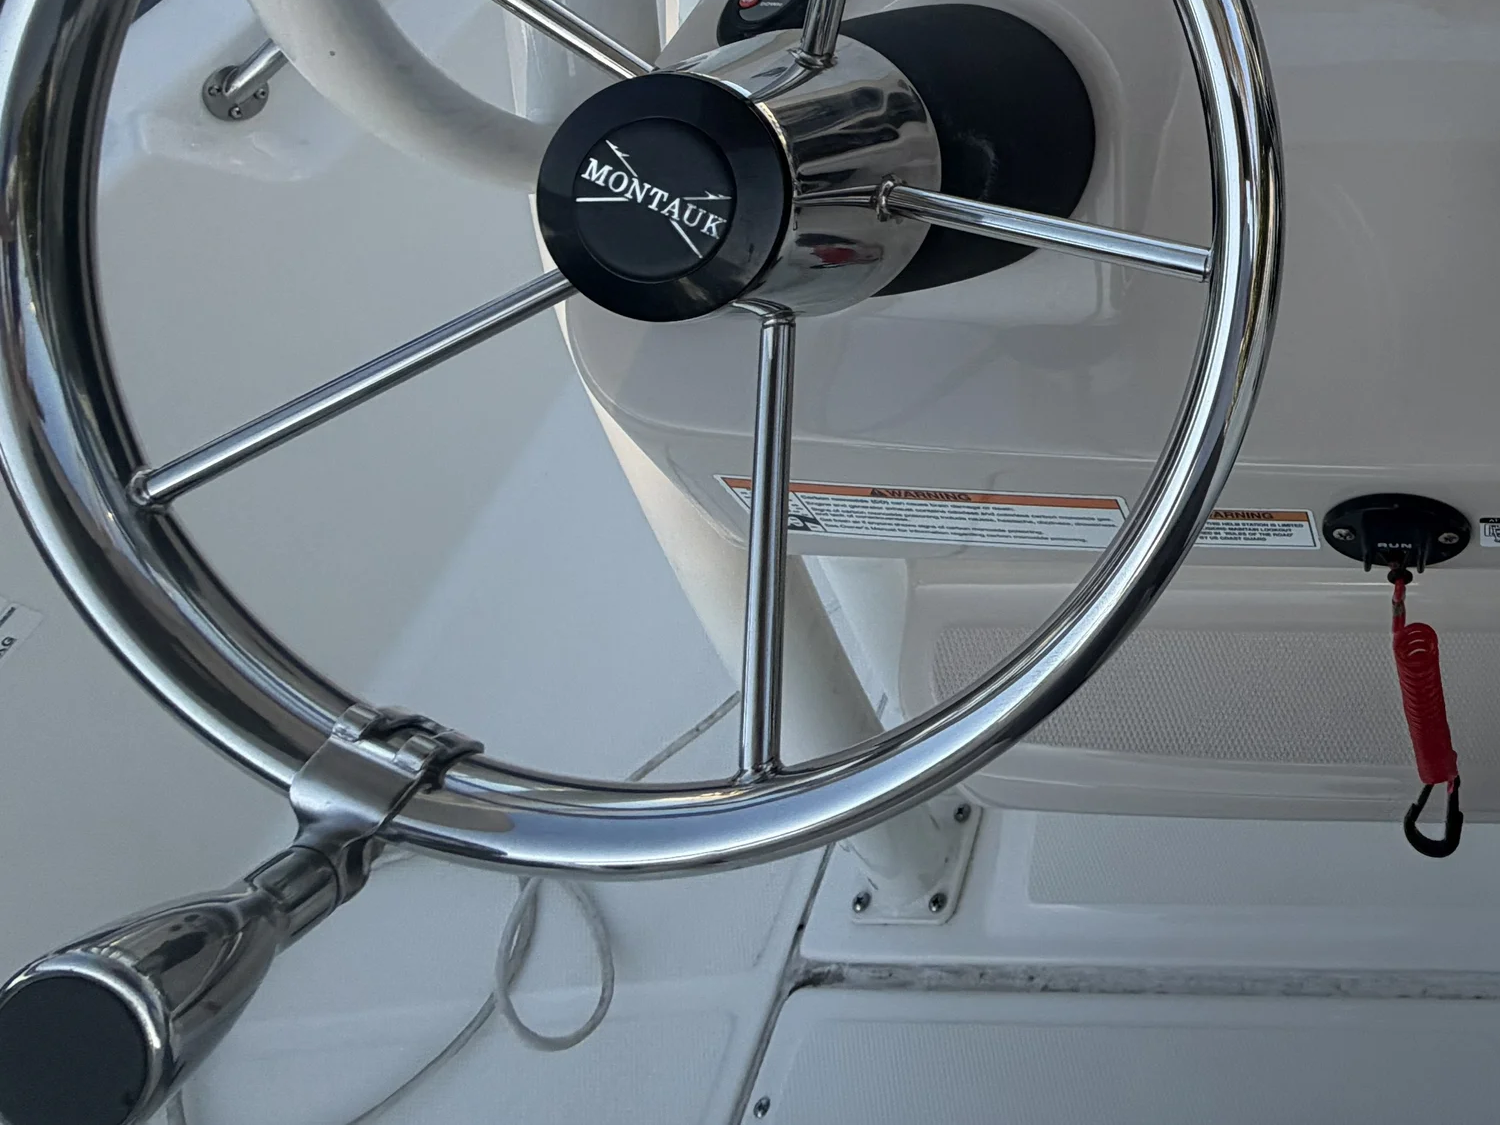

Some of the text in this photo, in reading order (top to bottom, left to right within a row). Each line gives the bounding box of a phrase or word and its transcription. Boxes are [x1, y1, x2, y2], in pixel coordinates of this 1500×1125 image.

[581, 157, 727, 240] MONTAUK
[884, 489, 972, 501] WARNING
[1210, 511, 1273, 519] ARNING
